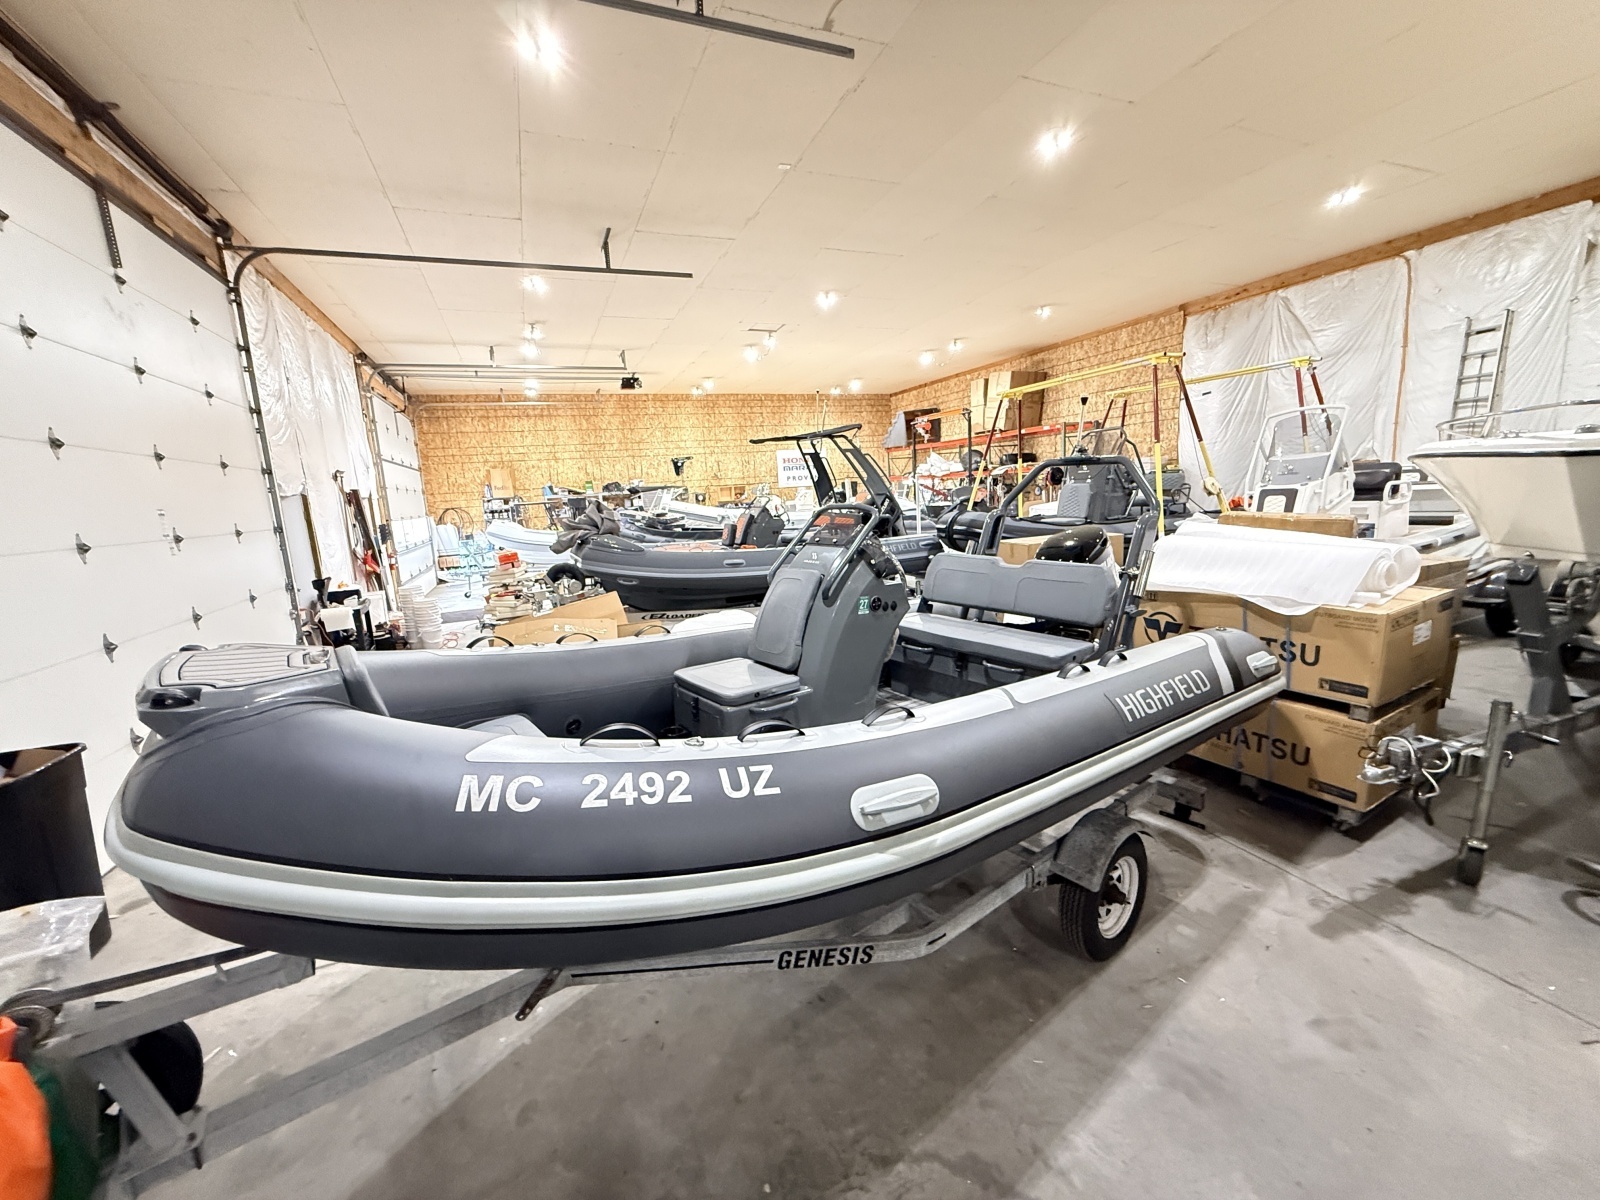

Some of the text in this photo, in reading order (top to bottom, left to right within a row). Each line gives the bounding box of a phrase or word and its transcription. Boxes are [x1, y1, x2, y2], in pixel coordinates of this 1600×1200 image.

[886, 543, 917, 551] HFIELD
[859, 599, 869, 609] 27
[1115, 669, 1211, 722] HIGHFIELD
[1216, 728, 1310, 766] HATSU
[455, 764, 781, 813] MC 2492 UZ
[777, 945, 874, 970] GENESIS
